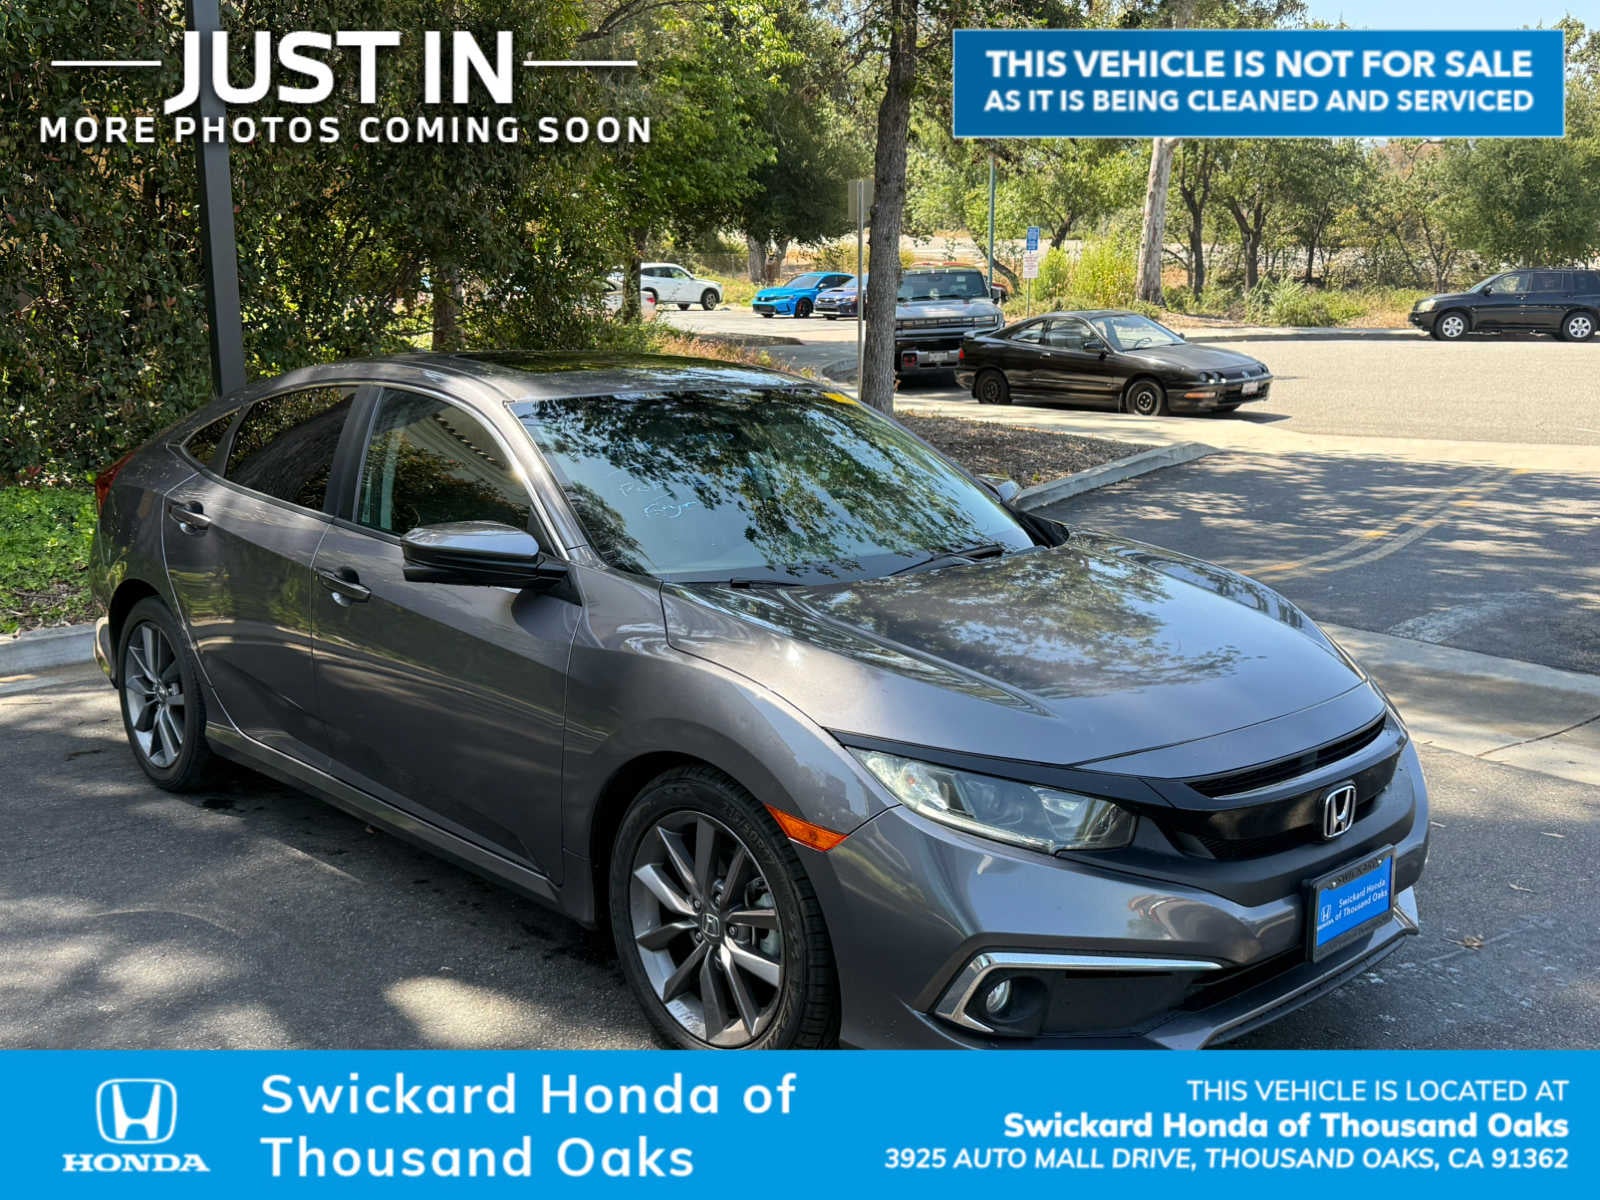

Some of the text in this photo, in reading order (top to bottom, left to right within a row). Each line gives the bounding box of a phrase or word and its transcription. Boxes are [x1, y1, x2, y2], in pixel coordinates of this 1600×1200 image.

[1334, 890, 1388, 921] of Thousand Oaks
[1338, 887, 1366, 908] Swickard
